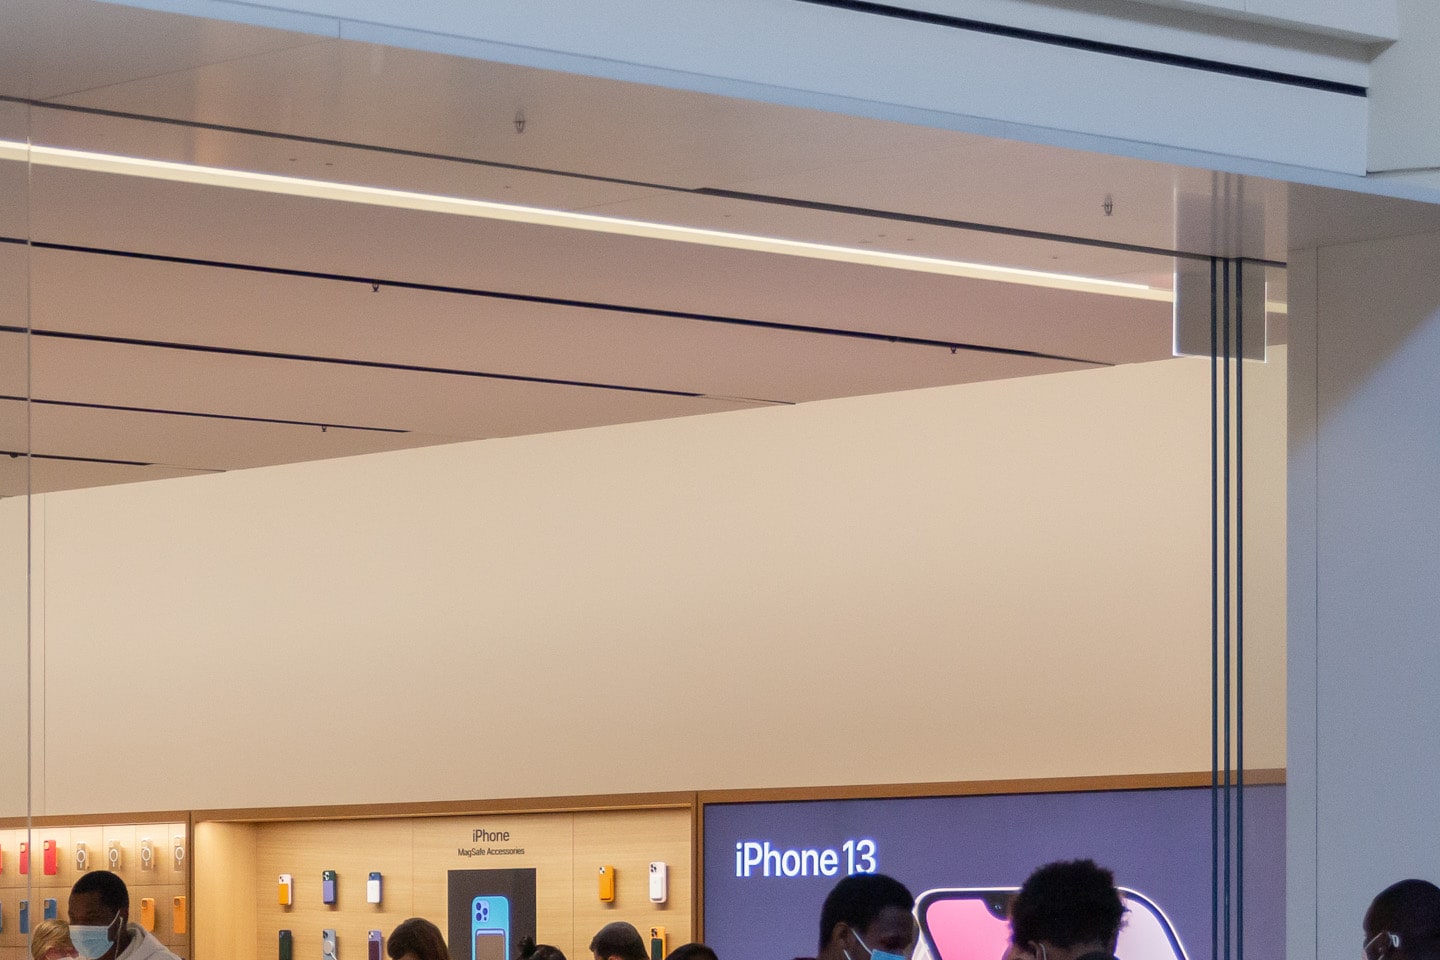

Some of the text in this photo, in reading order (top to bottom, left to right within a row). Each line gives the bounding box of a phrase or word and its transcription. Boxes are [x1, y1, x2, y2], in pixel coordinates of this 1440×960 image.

[472, 829, 510, 842] iPhone
[457, 847, 525, 858] MagSafe Accessories
[735, 838, 877, 877] iPhone 13
